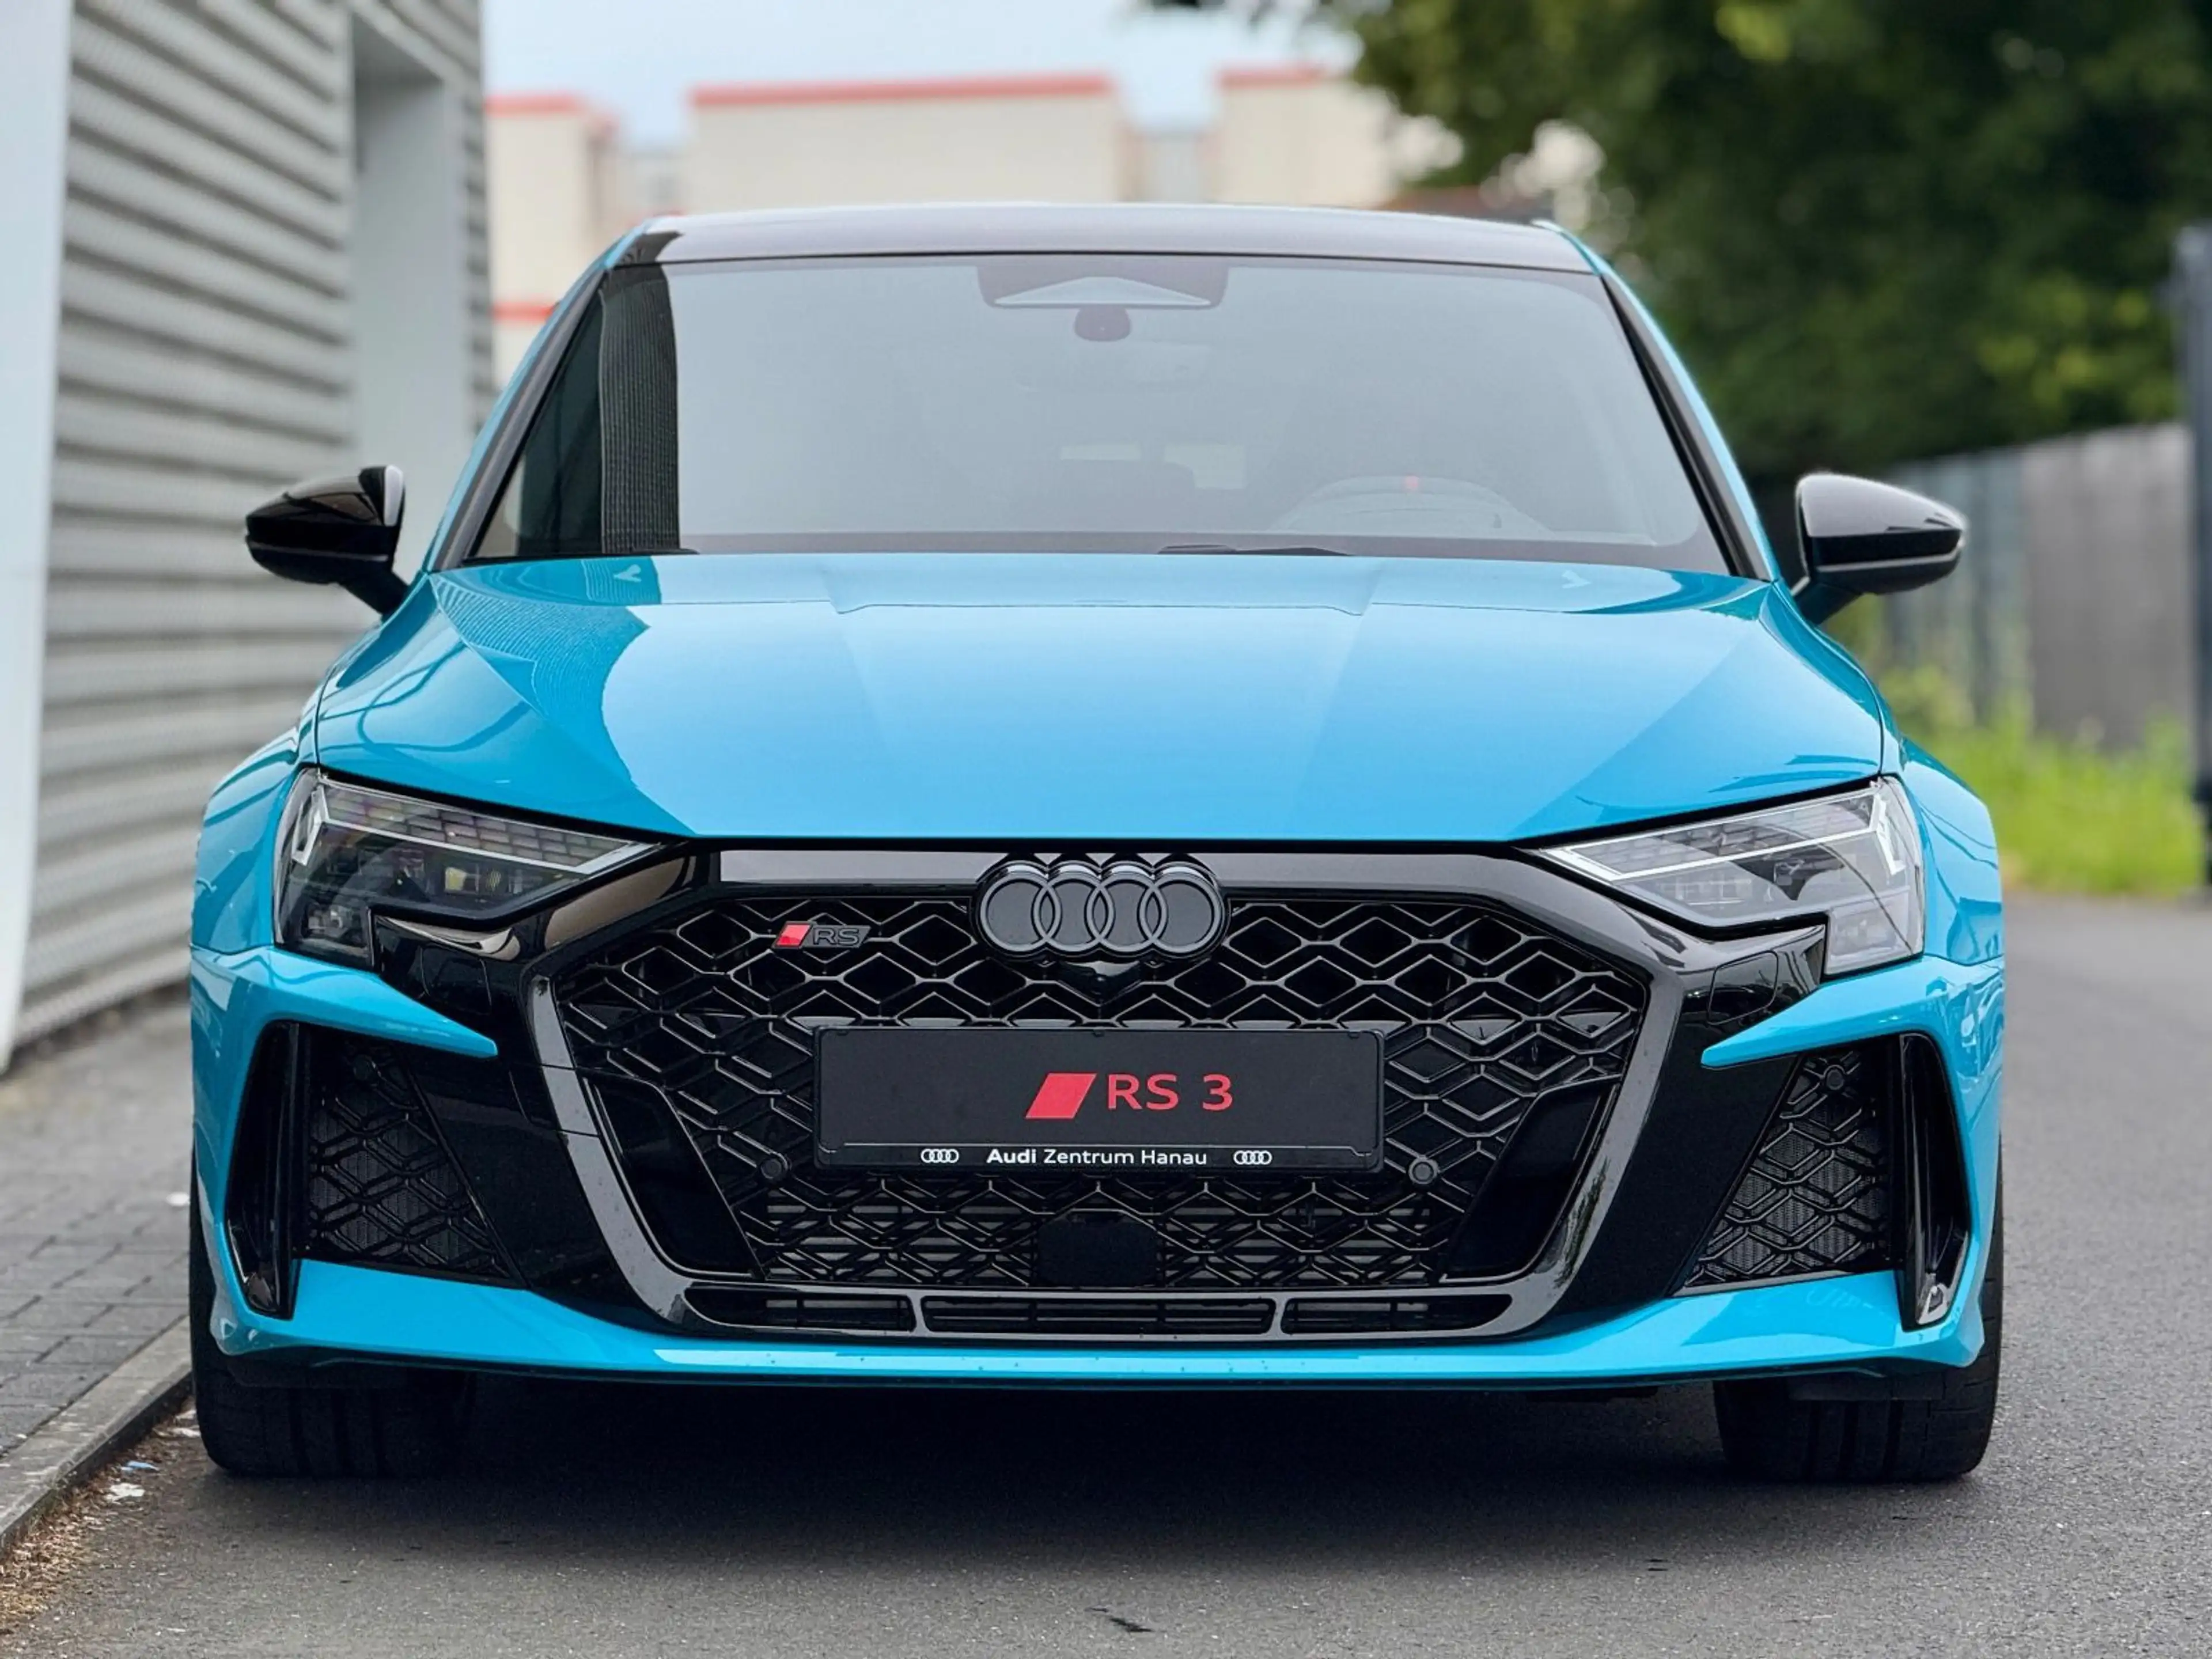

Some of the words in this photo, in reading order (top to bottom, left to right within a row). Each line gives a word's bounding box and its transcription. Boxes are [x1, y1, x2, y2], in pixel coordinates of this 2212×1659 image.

[813, 927, 859, 945] RS
[1107, 1073, 1179, 1111] RS
[1203, 1073, 1233, 1111] 3
[986, 1148, 1037, 1164] Audi
[1043, 1149, 1135, 1164] Zentrum
[1141, 1150, 1207, 1165] Hanau
